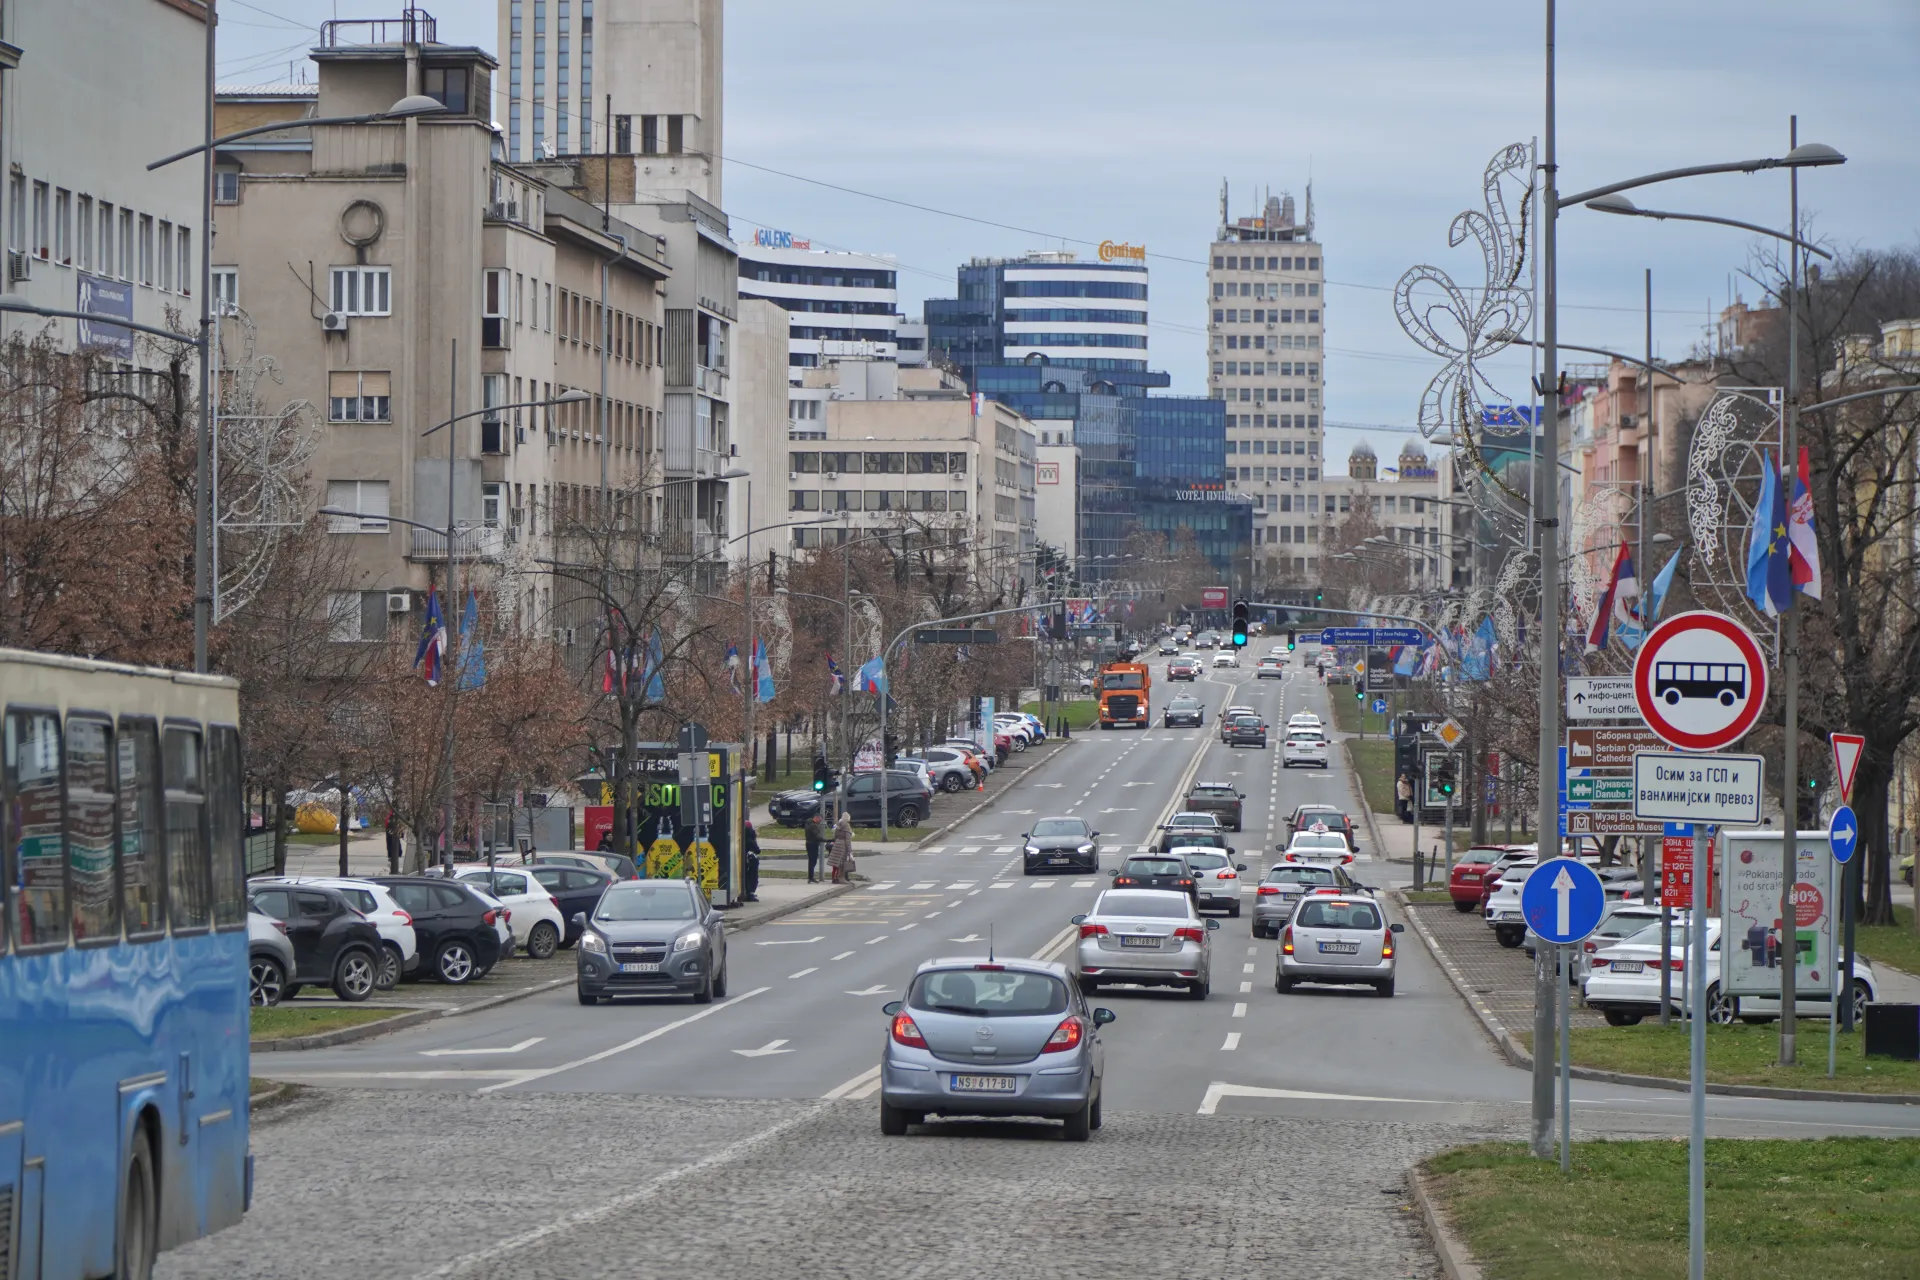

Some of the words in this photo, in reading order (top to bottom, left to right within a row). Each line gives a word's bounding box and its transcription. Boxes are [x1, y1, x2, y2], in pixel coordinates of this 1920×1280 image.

[759, 229, 791, 248] GALENS
[1175, 490, 1205, 501] ХОТЕЛ
[1587, 705, 1615, 714] Tourist
[1595, 731, 1631, 741] Саборна
[1595, 744, 1627, 752] Serbian
[1628, 744, 1666, 752] Orthodox
[1595, 753, 1633, 763] Cathedral
[657, 759, 679, 771] SPOR
[1656, 765, 1685, 781] Осим
[1689, 771, 1702, 782] за
[1706, 768, 1728, 783] ГСП
[1732, 772, 1739, 783] и
[1595, 789, 1626, 799] Danube
[1640, 788, 1711, 806] ванлинијски
[1715, 792, 1754, 807] превоз
[1595, 812, 1618, 822] Музеј
[1595, 823, 1635, 833] Vojvodina
[1636, 823, 1664, 831] Museu
[1800, 848, 1813, 857] dm
[1672, 862, 1685, 871] 120
[1743, 882, 1754, 891] od
[1664, 888, 1678, 897] 8211
[958, 1077, 971, 1088] NS
